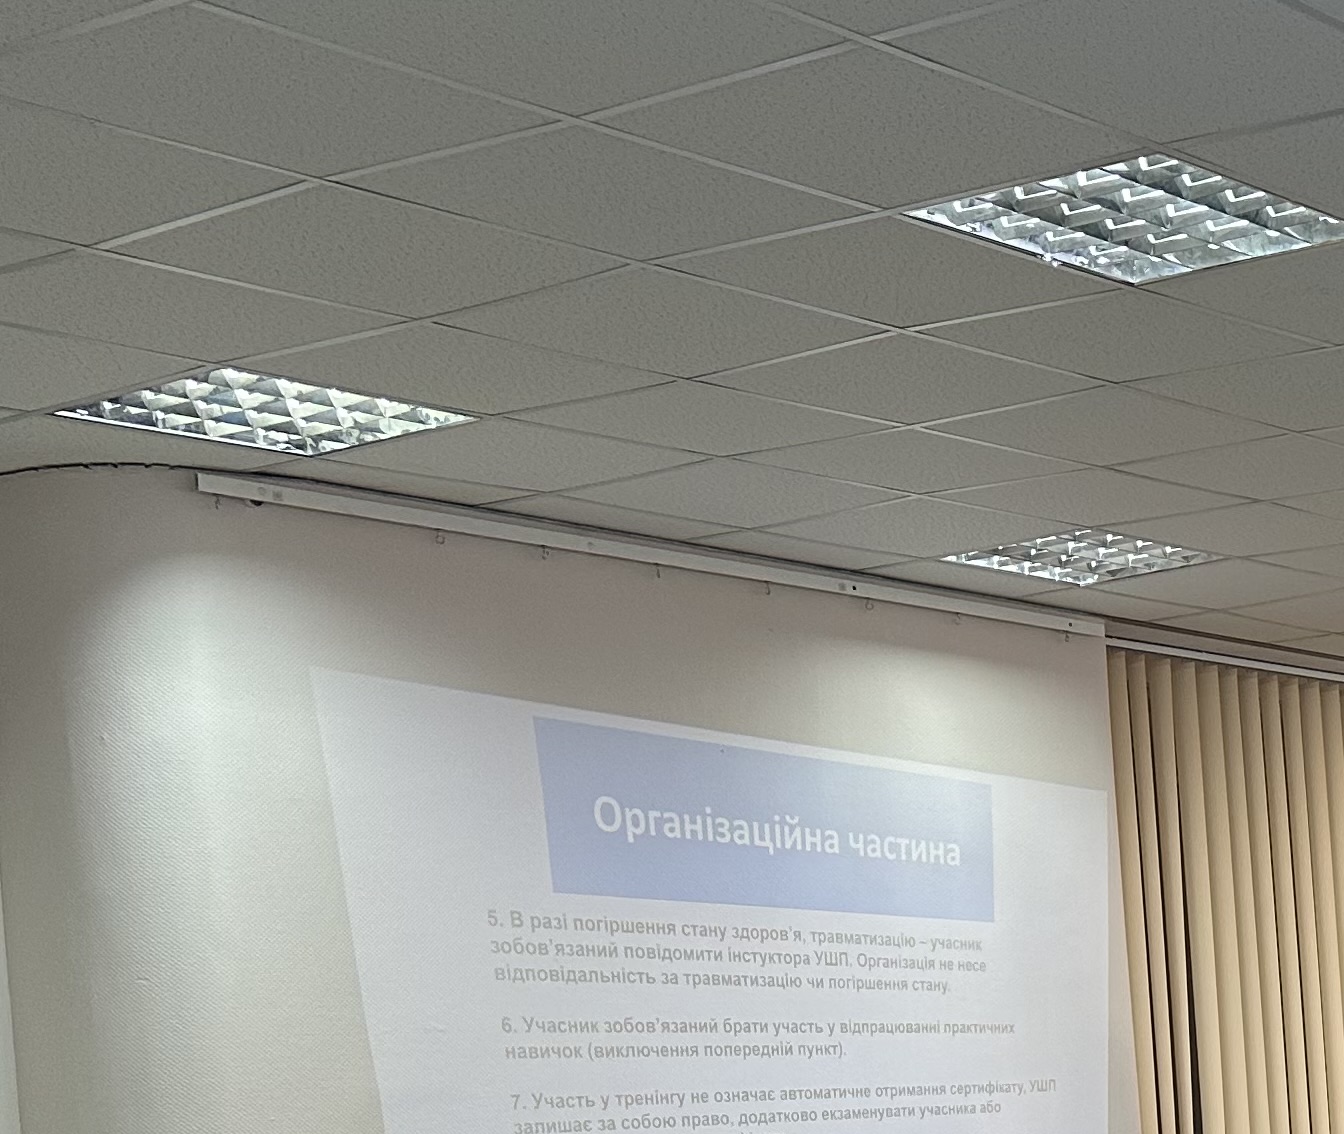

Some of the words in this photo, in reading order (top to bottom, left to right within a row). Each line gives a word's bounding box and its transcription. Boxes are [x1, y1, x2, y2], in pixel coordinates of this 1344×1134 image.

[593, 796, 840, 856] Організаційна
[849, 831, 961, 867] частина
[487, 909, 504, 928] 5.
[510, 910, 524, 928] В
[530, 913, 567, 932] разі
[573, 915, 677, 937] погіршення
[682, 923, 727, 942] стану
[810, 930, 916, 949] травматизацію
[930, 937, 982, 952] учасник
[624, 943, 723, 962] повідомити
[727, 947, 811, 968] інстуктора
[857, 952, 936, 971] Організація
[939, 959, 954, 971] не
[958, 959, 987, 972] несе
[495, 965, 656, 985] відповідальність
[661, 971, 679, 985] за
[683, 971, 802, 989] травматизацію
[807, 976, 825, 989] чи
[828, 975, 909, 992] погіршення
[501, 1016, 518, 1034] 6.
[522, 1016, 600, 1034] Учасник
[723, 1017, 769, 1037] брати
[773, 1021, 823, 1037] участь
[828, 1021, 836, 1037] у
[840, 1019, 941, 1036] відпрацюванні
[943, 1022, 1015, 1036] практичних
[505, 1044, 583, 1060] навичок
[588, 1041, 699, 1062] (виключення
[704, 1041, 793, 1060] попередній
[510, 1092, 527, 1110] 7.
[531, 1092, 595, 1110] Участь
[600, 1093, 610, 1110] у
[615, 1090, 685, 1109] тренінгу
[691, 1091, 709, 1103] не
[714, 1088, 776, 1104] означає
[780, 1085, 871, 1101] автоматичне
[875, 1083, 946, 1100] отримання
[1029, 1079, 1056, 1094] УШП
[598, 1118, 617, 1131] за
[621, 1114, 677, 1130] собою
[738, 1109, 818, 1127] додатково
[822, 1104, 916, 1122] екзаменувати
[919, 1102, 977, 1119] учасника
[979, 1101, 1001, 1114] або
